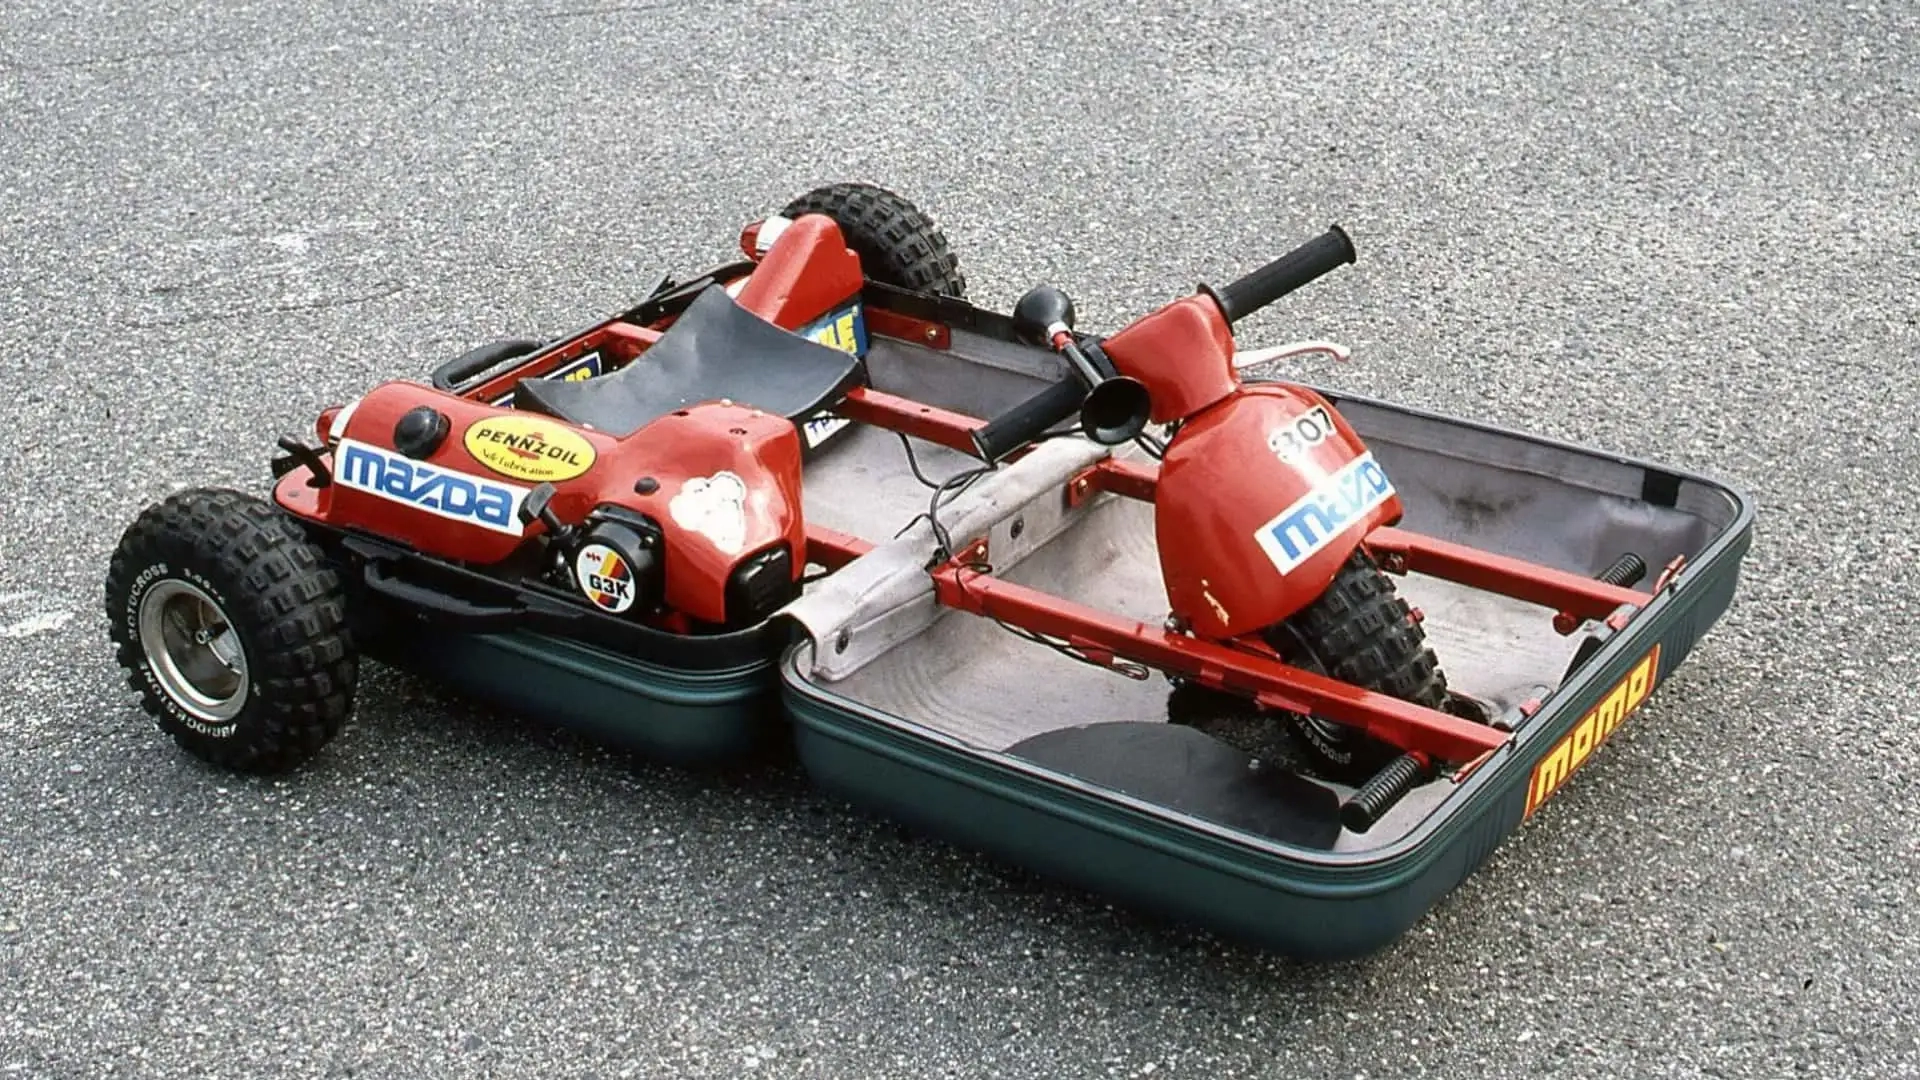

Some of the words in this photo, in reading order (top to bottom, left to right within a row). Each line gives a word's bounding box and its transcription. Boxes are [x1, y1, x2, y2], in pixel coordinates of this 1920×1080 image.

[344, 446, 514, 527] mazda
[476, 428, 580, 466] PENNZOIL
[1271, 461, 1388, 560] mazd
[127, 562, 169, 641] MOTOCROSS
[589, 574, 629, 599] G3K
